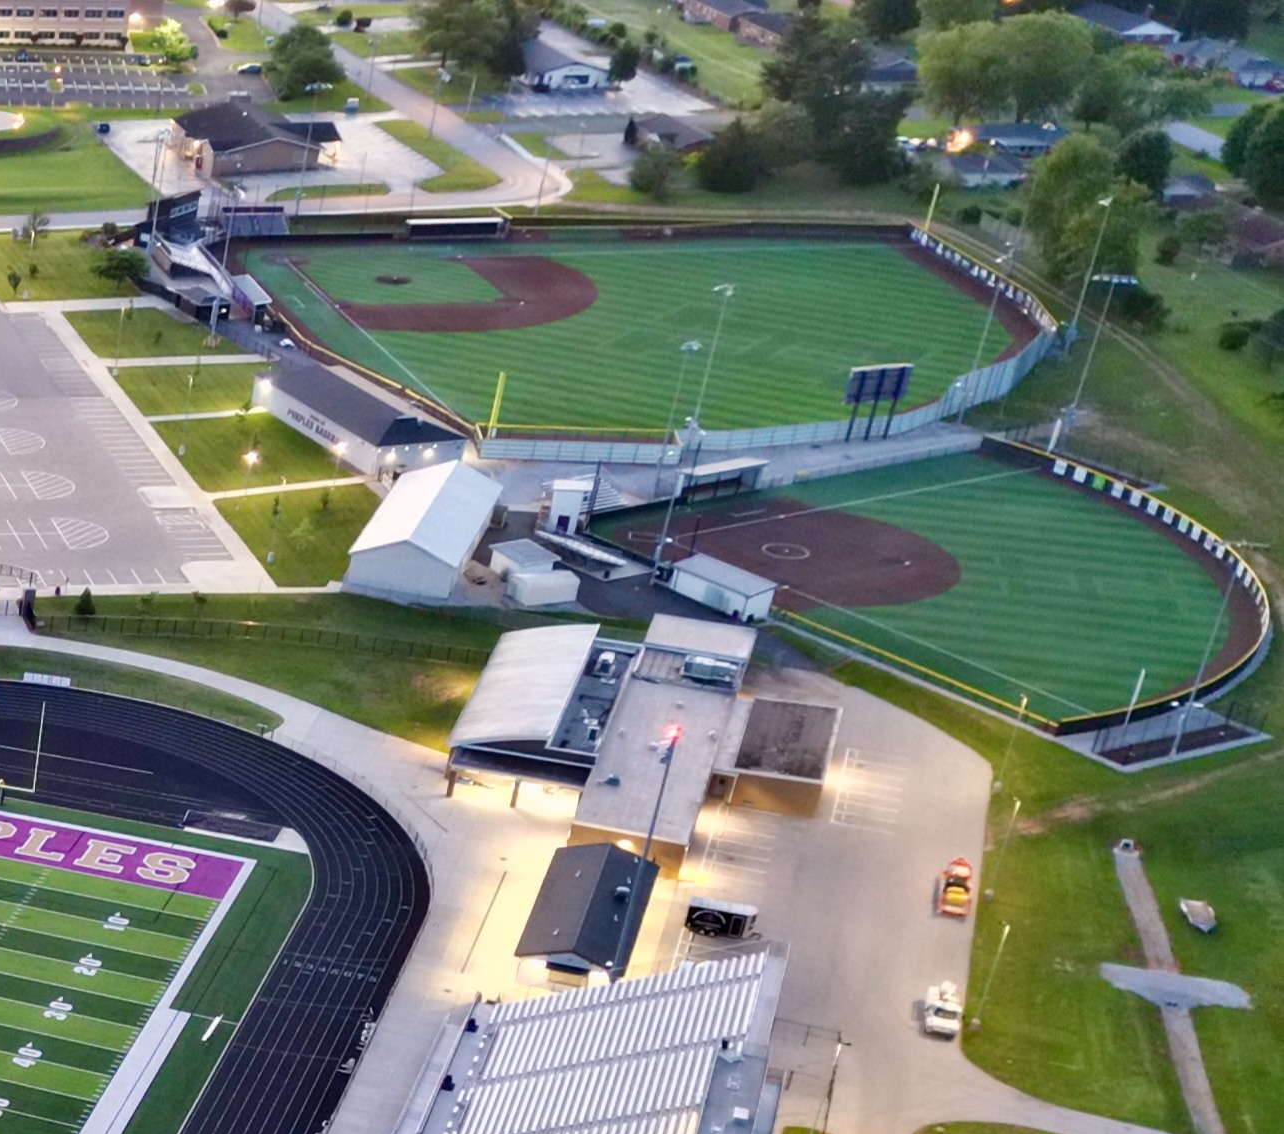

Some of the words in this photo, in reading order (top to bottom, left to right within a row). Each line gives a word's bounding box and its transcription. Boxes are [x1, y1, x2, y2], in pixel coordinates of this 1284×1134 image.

[73, 957, 103, 977] 20
[43, 1001, 73, 1021] 30
[12, 1047, 43, 1068] 40
